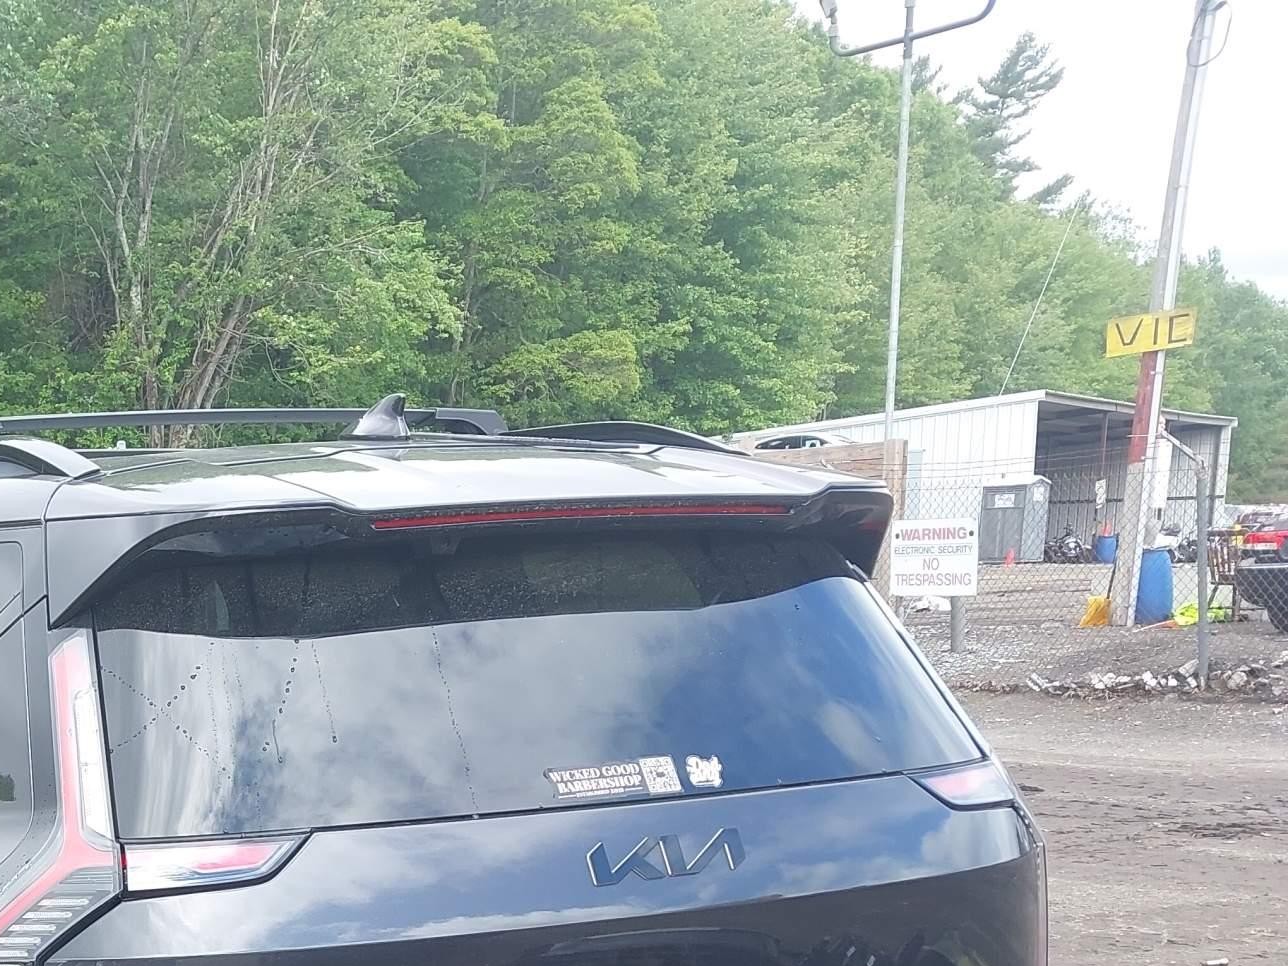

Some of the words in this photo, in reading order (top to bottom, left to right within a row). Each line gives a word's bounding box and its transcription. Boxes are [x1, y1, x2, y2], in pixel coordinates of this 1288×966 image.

[900, 527, 967, 541] WARNING
[894, 546, 935, 555] ELECTRONIC
[937, 545, 973, 554] SECURITY
[922, 557, 940, 570] NO
[895, 572, 972, 586] TRESPASSING
[549, 768, 600, 783] WICKED
[602, 763, 640, 777] GOOD
[558, 775, 642, 793] BARBERSHOP
